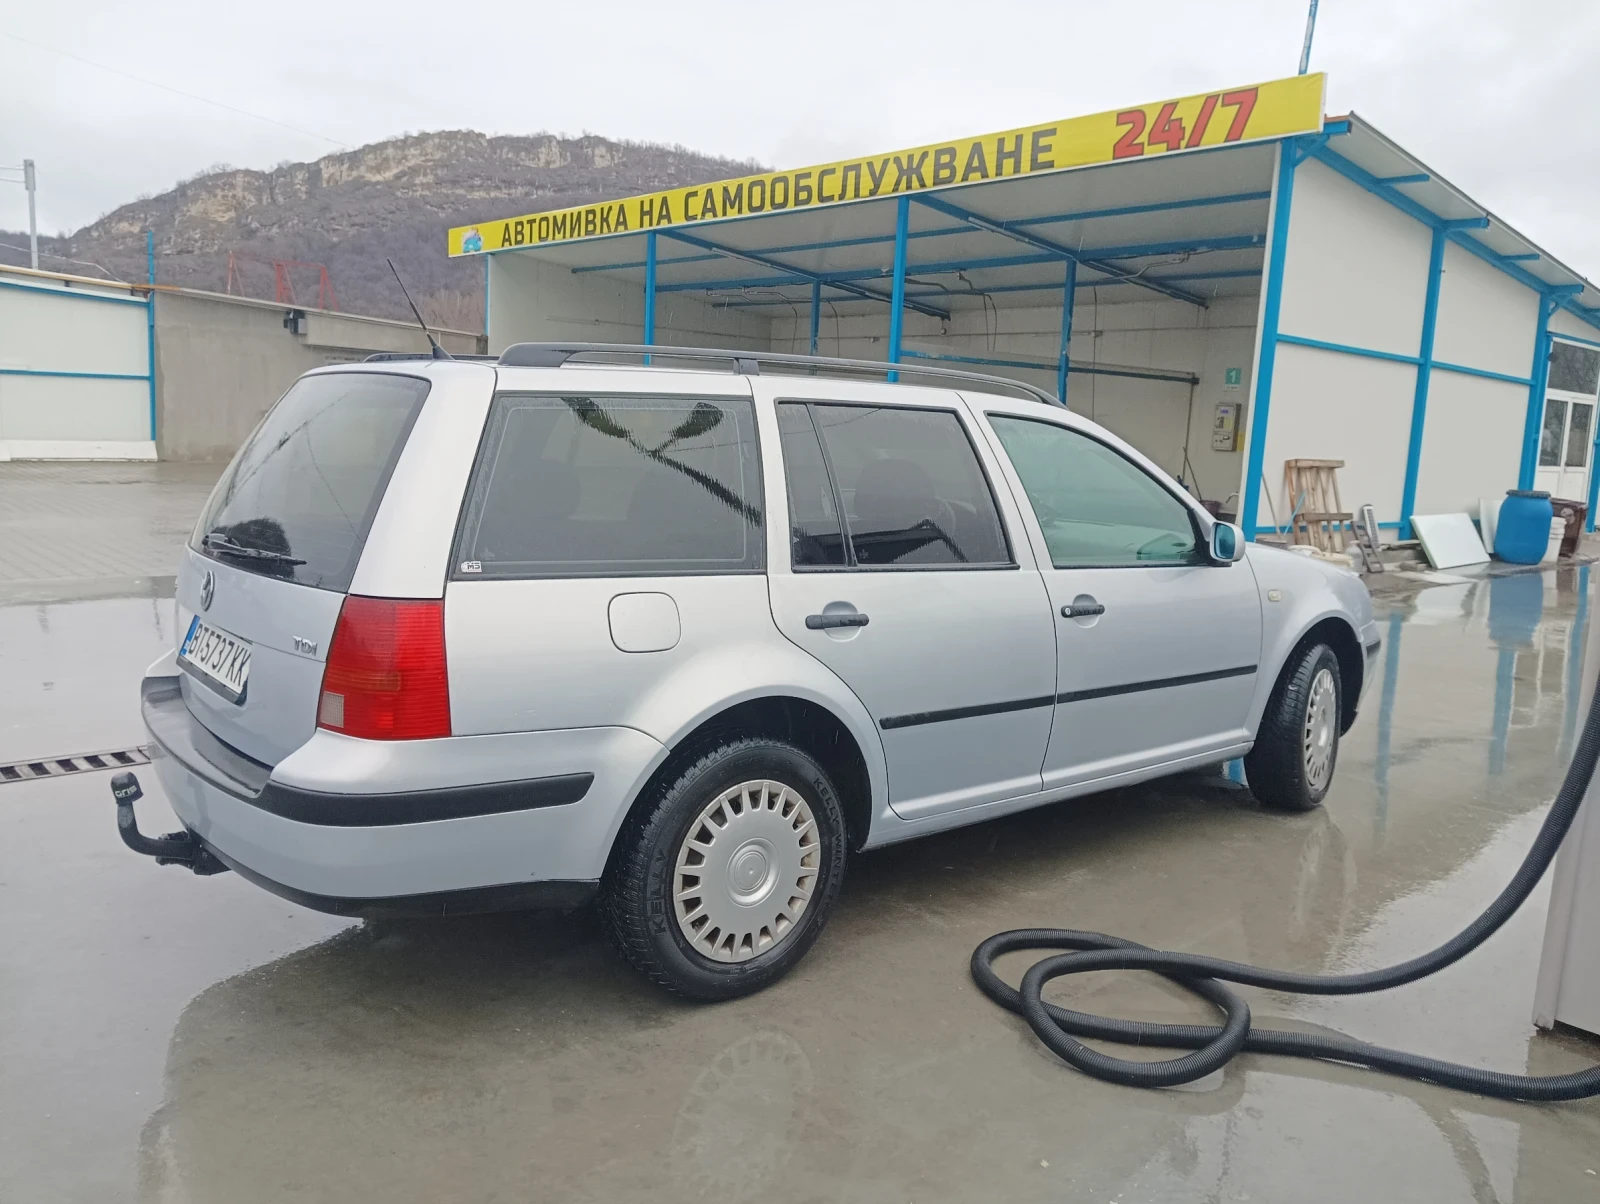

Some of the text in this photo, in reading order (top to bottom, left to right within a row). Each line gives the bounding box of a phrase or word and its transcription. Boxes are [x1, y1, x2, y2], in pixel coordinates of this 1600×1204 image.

[501, 87, 1258, 248] АВТОМИВКА НА САМООБСЛУЖВАНЕ 24/7
[1229, 369, 1238, 383] 1
[813, 777, 840, 824] KELLY
[650, 847, 667, 935] KELLY
